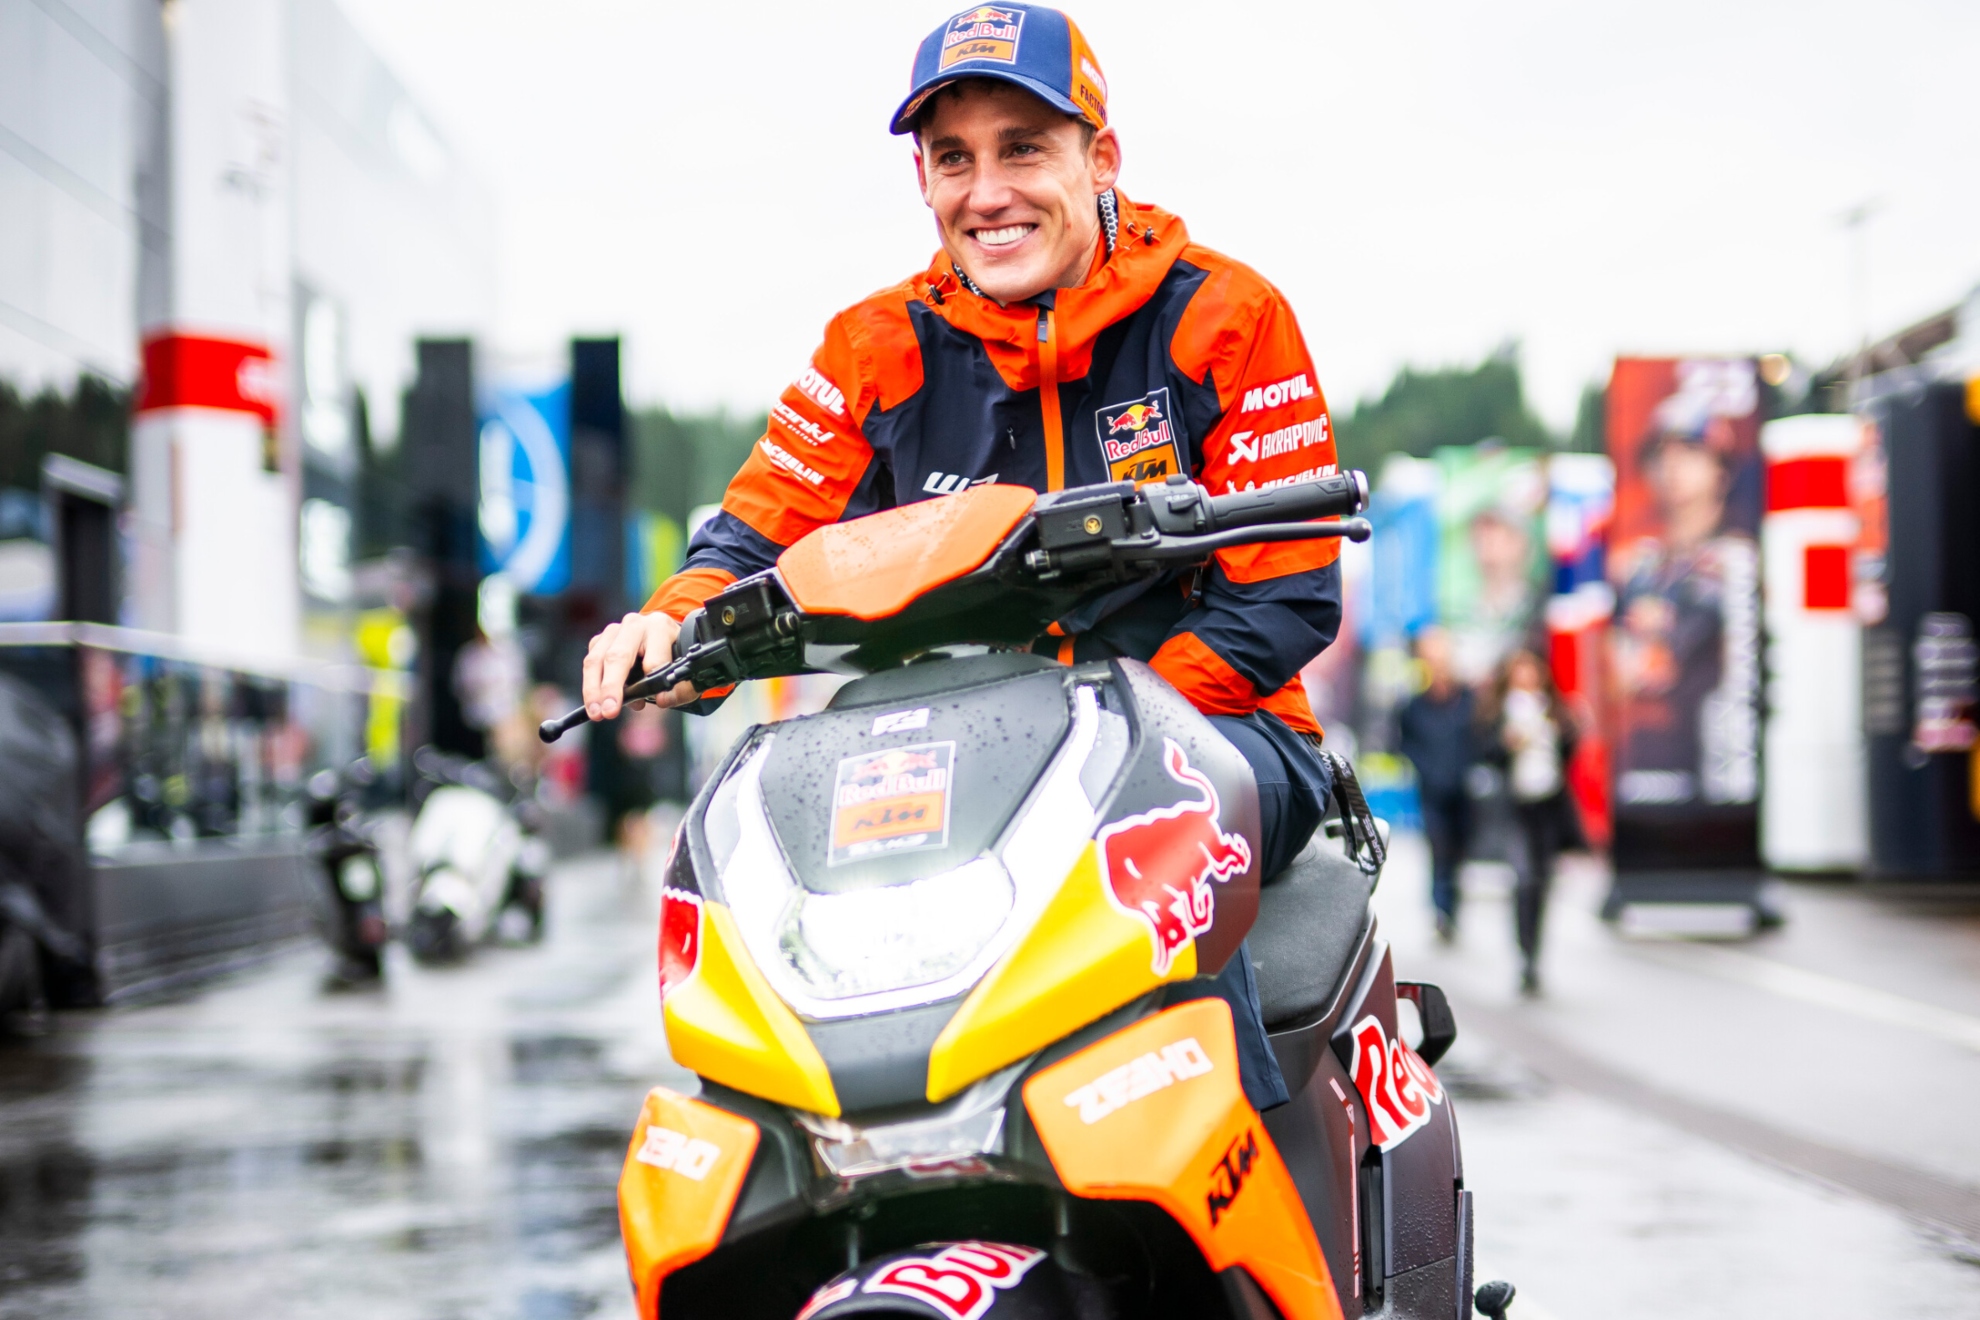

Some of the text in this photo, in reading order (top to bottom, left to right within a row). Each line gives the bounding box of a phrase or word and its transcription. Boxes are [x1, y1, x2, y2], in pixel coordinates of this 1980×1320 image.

[946, 22, 1017, 47] Red Bull
[956, 42, 997, 58] KTM
[801, 367, 846, 416] OTUL
[1241, 374, 1314, 414] MOTUL
[1105, 419, 1171, 461] Red Bull
[1122, 458, 1167, 481] KTM
[838, 767, 947, 806] Red Bull
[1207, 1128, 1258, 1229] KTM
